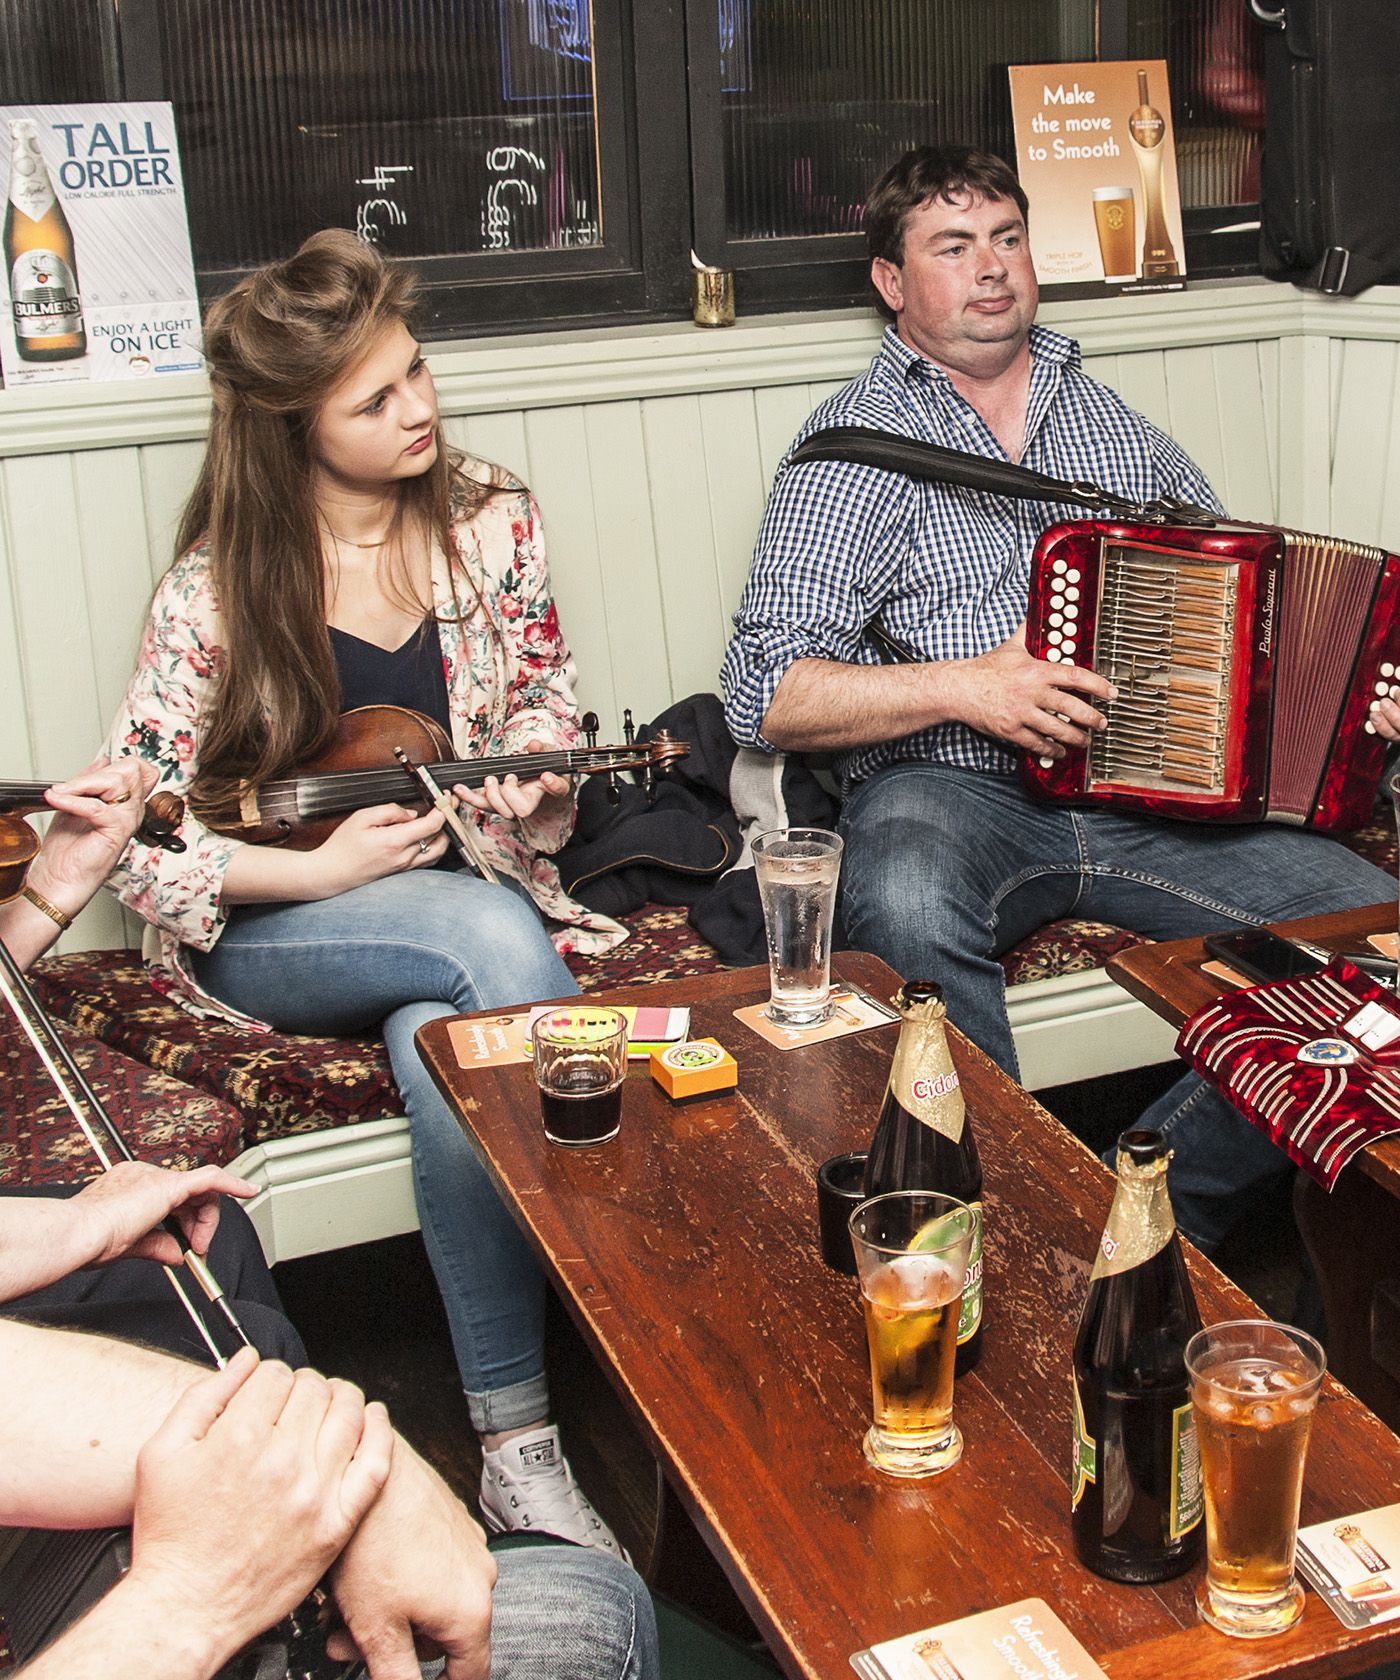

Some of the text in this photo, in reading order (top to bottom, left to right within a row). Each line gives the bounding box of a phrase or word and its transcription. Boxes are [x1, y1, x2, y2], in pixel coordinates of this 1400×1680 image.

[1043, 83, 1095, 106] Make
[1032, 112, 1061, 134] the
[1065, 117, 1111, 133] move
[52, 122, 170, 157] TALL
[1028, 136, 1120, 161] to Smooth
[59, 157, 174, 190] ORDER
[64, 187, 176, 200] LOW CALORIE FULL STRENGTH
[15, 299, 79, 316] BULMERS
[92, 319, 193, 337] ENJOY A LIGHT
[110, 333, 182, 353] ON ICE
[1258, 568, 1277, 658] Paolo Soprani
